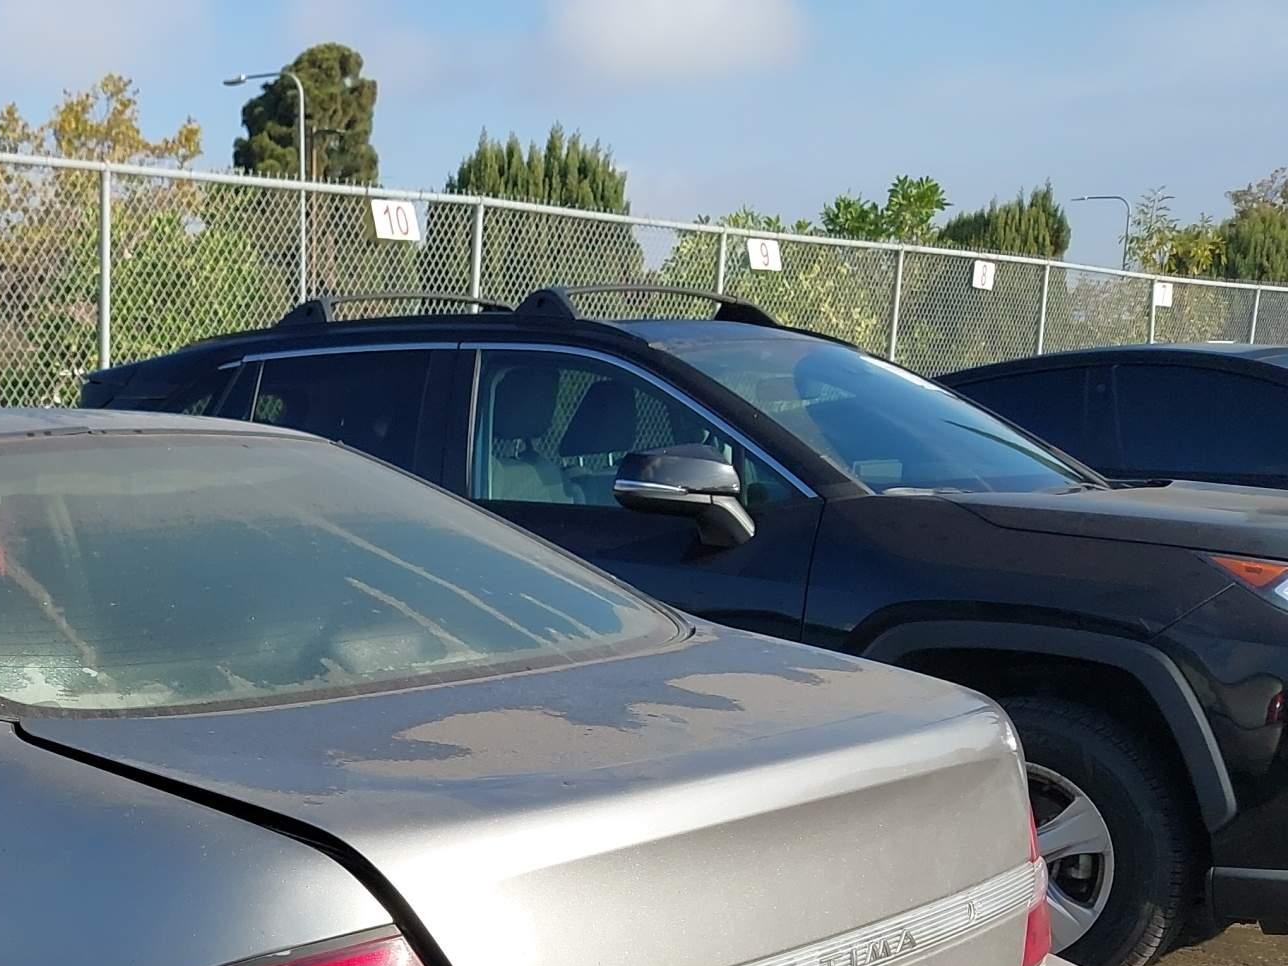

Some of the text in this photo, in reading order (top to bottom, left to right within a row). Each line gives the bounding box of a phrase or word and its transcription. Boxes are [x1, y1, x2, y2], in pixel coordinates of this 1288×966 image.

[383, 204, 409, 236] 10
[759, 242, 770, 267] 9
[980, 264, 988, 286] 8
